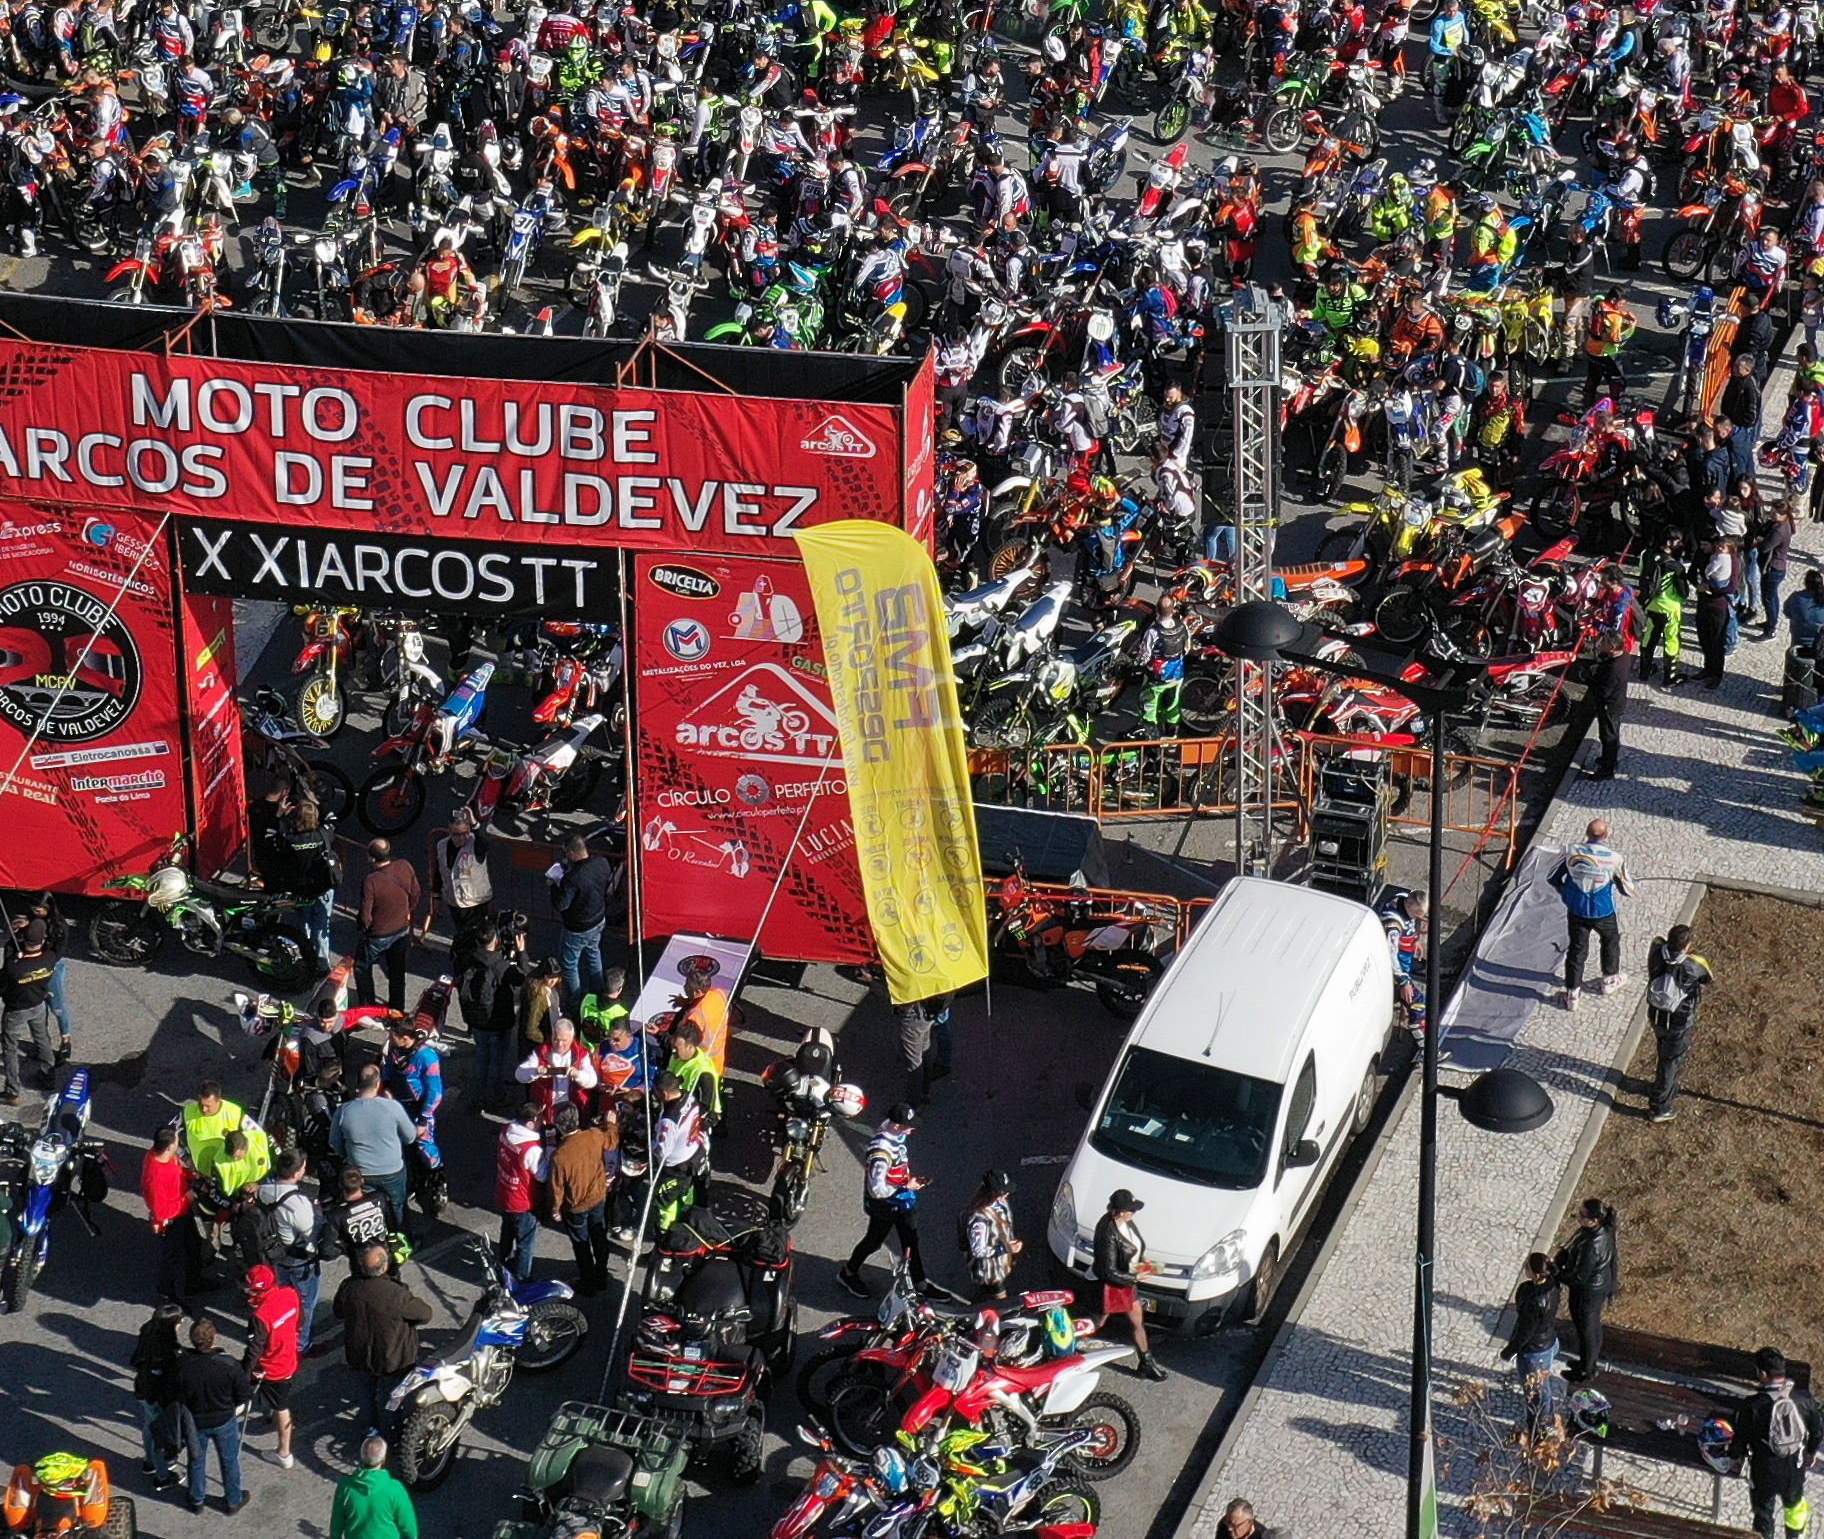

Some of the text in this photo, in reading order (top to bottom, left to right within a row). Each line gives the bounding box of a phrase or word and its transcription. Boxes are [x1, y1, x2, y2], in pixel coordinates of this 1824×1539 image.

[132, 372, 657, 464] MOTO CLUBE
[275, 450, 373, 512] DE
[414, 462, 820, 539] VALDEVEZ
[653, 567, 716, 596] BRICELTA
[36, 612, 66, 625] 1994
[50, 587, 117, 635] CLUBE
[57, 698, 126, 737] VALDEVEZ
[676, 721, 786, 751] arcos
[71, 745, 152, 764] Eletrocanossa
[657, 779, 847, 808] CÍRCULO PERFEITO
